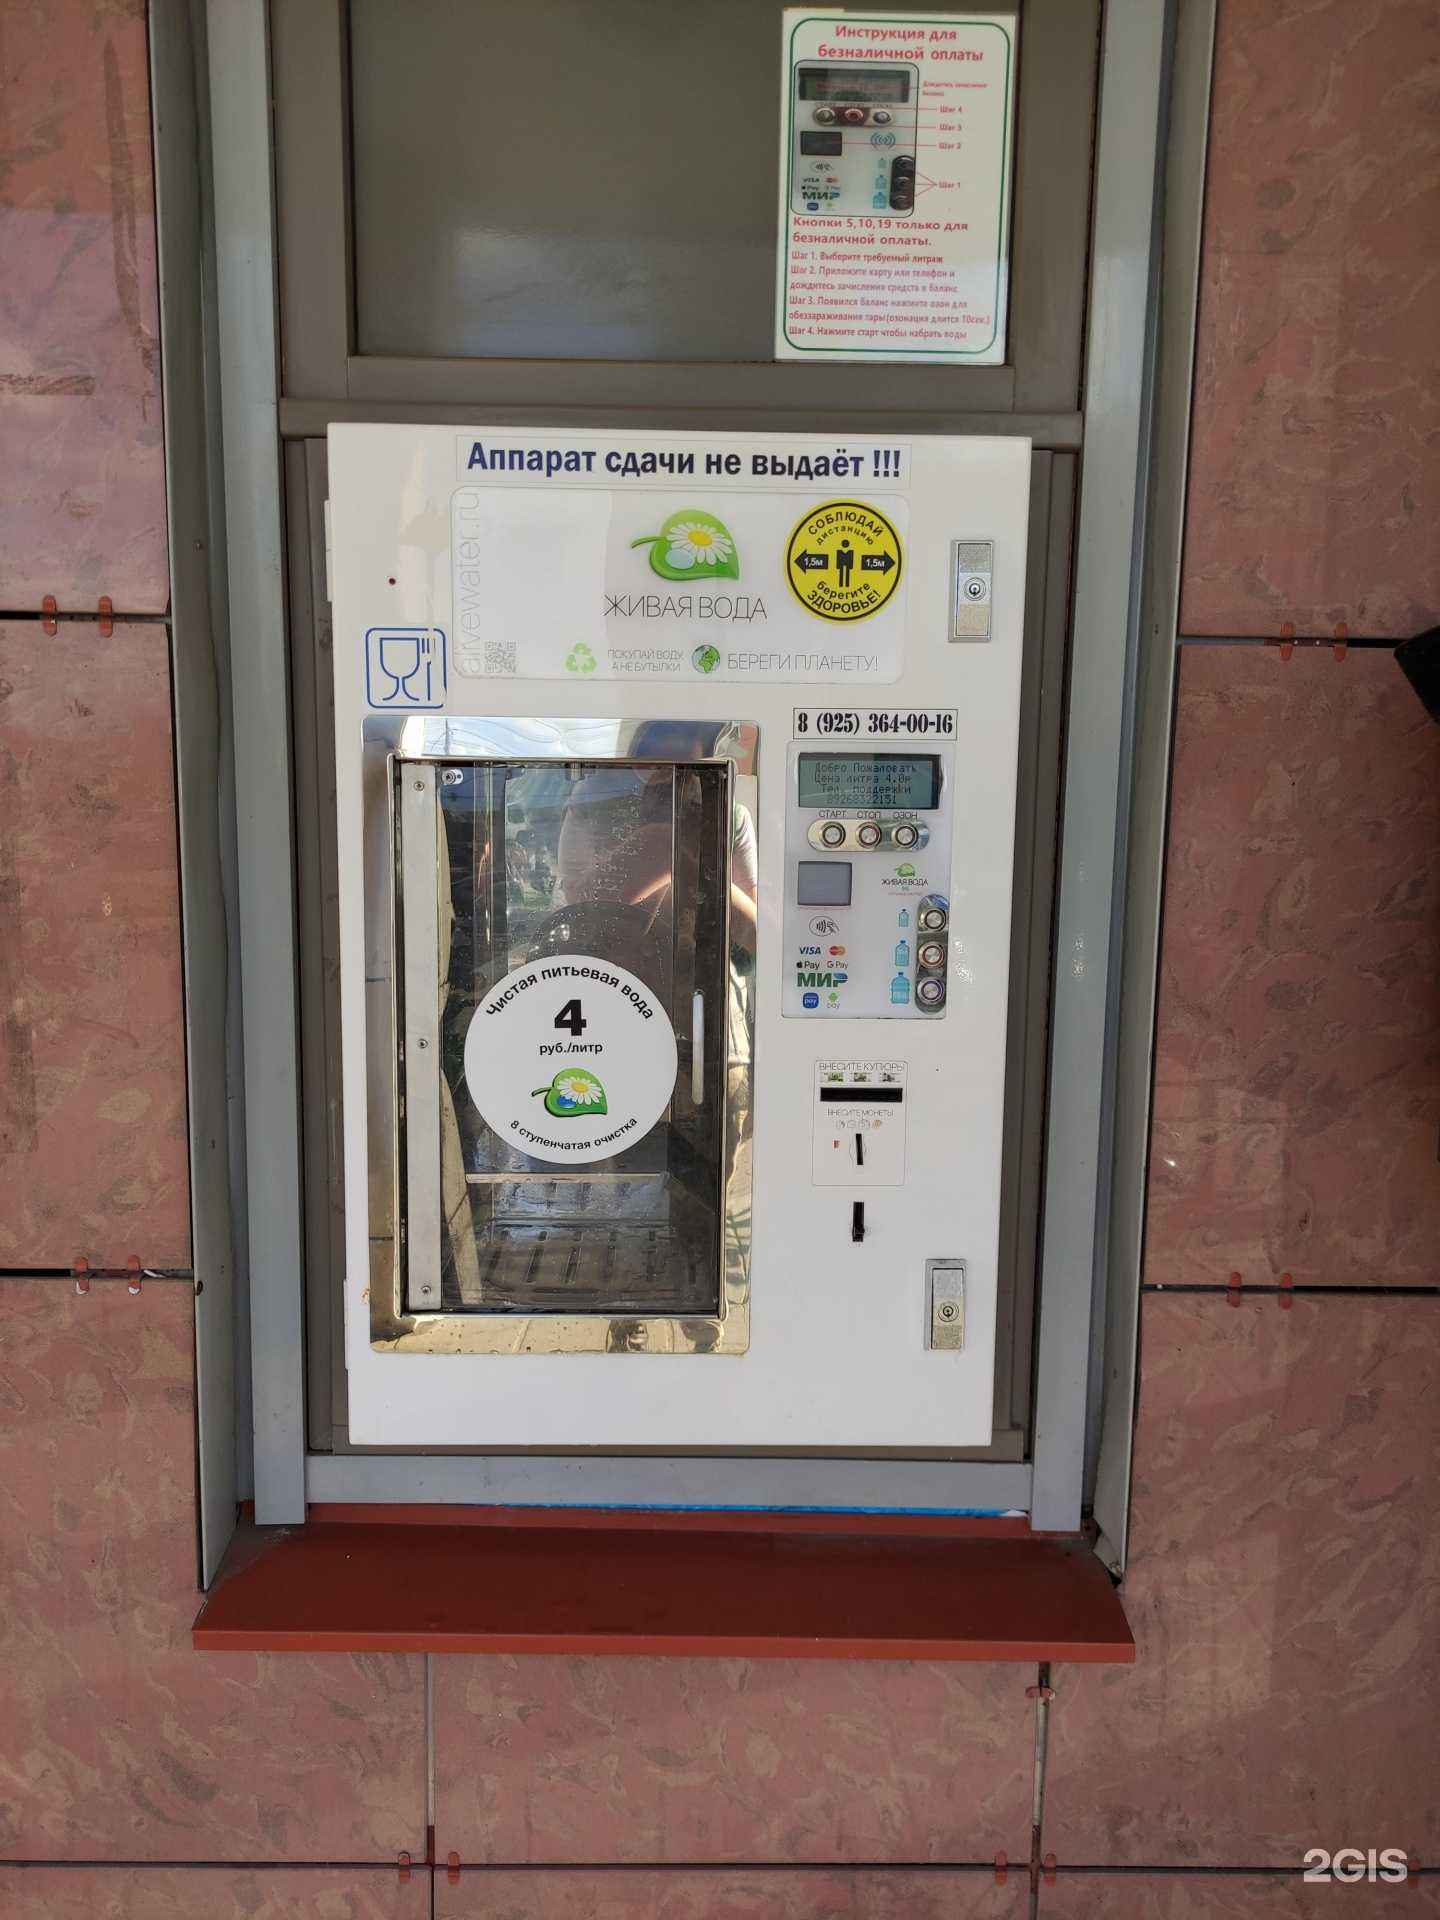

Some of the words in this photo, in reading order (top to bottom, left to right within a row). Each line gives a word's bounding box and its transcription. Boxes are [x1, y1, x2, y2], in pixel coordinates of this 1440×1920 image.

[835, 25, 925, 43] Инструкция
[929, 30, 957, 43] для
[818, 43, 924, 60] безналичной
[931, 50, 983, 61] оплаты
[939, 105, 955, 114] Шаг
[939, 123, 955, 132] Шаг
[939, 142, 955, 151] Шаг
[956, 142, 961, 150] 2
[938, 181, 954, 190] Шаг
[794, 217, 842, 227] Кнопки
[895, 221, 940, 230] только
[944, 223, 968, 232] для
[793, 232, 875, 244] безналичной
[880, 236, 931, 246] оплаты.
[792, 251, 808, 259] Шаг
[820, 252, 861, 262] Выберите
[864, 253, 909, 264] требуемый
[912, 256, 943, 265] литраж
[791, 266, 807, 274] Шаг
[819, 266, 866, 277] Приложите
[869, 269, 892, 278] карту
[912, 269, 947, 279] телефон
[791, 282, 835, 291] дождитесь
[929, 283, 958, 292] баланс
[789, 296, 806, 304] Шаг
[817, 297, 858, 305] Появился
[860, 297, 888, 306] баланс
[789, 326, 805, 334] Шаг
[817, 327, 855, 336] Нажмите
[857, 329, 879, 338] старт
[881, 328, 906, 337] чтобы
[910, 328, 942, 339] набрать
[468, 442, 596, 477] Аппарат
[606, 449, 694, 479] сдачи
[706, 452, 741, 474] не
[752, 449, 864, 480] выдаёт
[873, 450, 900, 477] !!!
[808, 511, 883, 537] СОБЛЮДАЙ
[816, 525, 874, 546] дистанцию
[817, 580, 870, 600] берегите
[807, 589, 881, 613] ЗДОРОВЬЕ!
[603, 594, 692, 618] ЖИВАЯ
[699, 596, 769, 623] ВОДА
[634, 662, 681, 673] БУТЫЛКИ
[727, 653, 792, 671] БЕРЕГИ
[795, 654, 879, 672] ПЛАНЕТУ!
[798, 712, 808, 733] 8
[816, 713, 860, 735] (925)
[868, 713, 953, 733] 364-00-16
[815, 762, 847, 773] Добро
[854, 763, 917, 773] Пожаловать
[815, 772, 840, 784] Цена
[847, 775, 879, 783] литра
[818, 810, 847, 818] СТАРТ
[857, 811, 880, 819] СТОП
[893, 811, 918, 819] ОЗОН
[908, 878, 929, 886] ВОДА
[799, 946, 821, 955] VISA
[804, 961, 820, 970] Pay
[835, 961, 848, 970] Pay
[797, 973, 848, 987] МИР
[486, 974, 538, 1017] Чистая
[541, 966, 620, 988] питьевая
[620, 983, 654, 1019] вода
[554, 999, 587, 1036] 4
[539, 1042, 603, 1055] руб./литр
[819, 1062, 861, 1071] ВНЕСИТЕ
[863, 1063, 904, 1072] КУПЮРЫ
[510, 1120, 519, 1129] 8
[519, 1127, 591, 1150] ступенчатая
[594, 1117, 638, 1146] очистка
